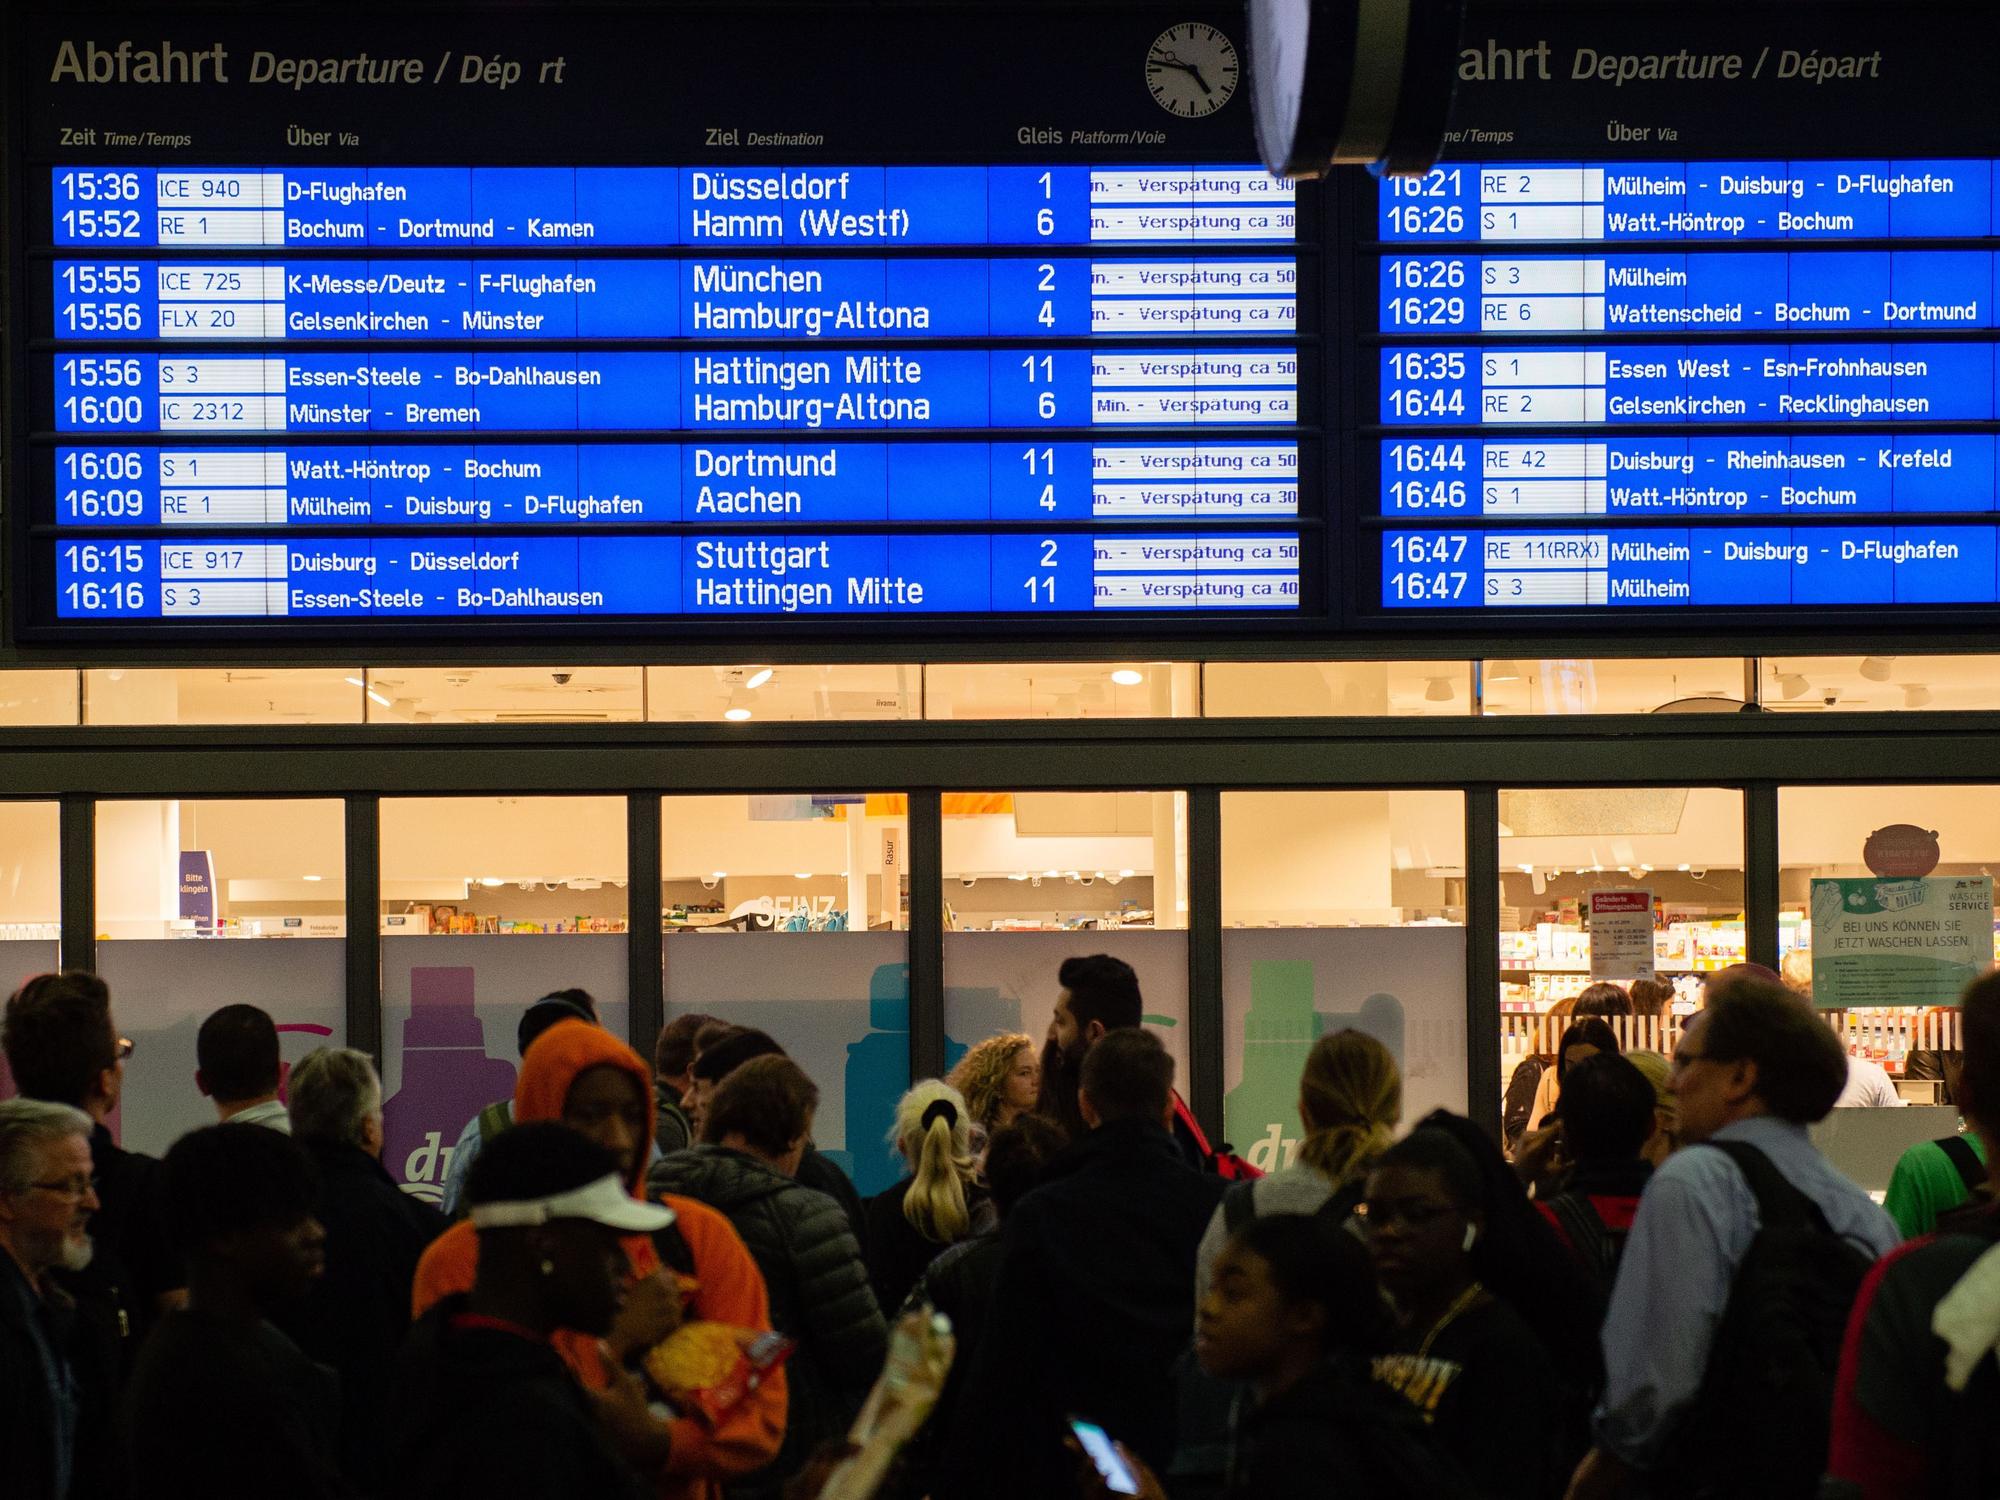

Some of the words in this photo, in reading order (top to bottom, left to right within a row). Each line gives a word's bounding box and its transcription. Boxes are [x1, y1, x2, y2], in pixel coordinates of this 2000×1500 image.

[50, 41, 229, 83] Abfahrt
[249, 52, 424, 91] Departure
[1458, 39, 1551, 81] ahrt
[1571, 48, 1742, 87] Departure
[1778, 47, 1882, 85] Départ
[60, 127, 97, 146] Zeit
[103, 131, 192, 149] Time/Temps
[287, 124, 332, 146] Über
[339, 132, 360, 146] Via
[705, 128, 740, 146] Ziel
[747, 132, 824, 146] Destination
[1017, 126, 1063, 145] Gleis
[1070, 130, 1166, 145] Platform/Voie
[1607, 120, 1651, 142] Über
[1657, 127, 1678, 141] Via
[60, 172, 140, 201] 15:36
[160, 179, 190, 198] ICE
[201, 179, 240, 198] 940
[287, 181, 407, 206] D-Flughafen
[692, 172, 850, 201] Düsseldorf
[1038, 171, 1051, 199] 1
[1387, 171, 1461, 197] 16:21
[1484, 175, 1507, 193] RE
[1519, 175, 1531, 193] 2
[1607, 176, 1686, 196] Mülheim
[1720, 175, 1804, 199] Duisburg
[1837, 173, 1954, 198] D-Flughafen
[61, 209, 141, 238] 15:52
[160, 216, 185, 235] RE
[198, 216, 207, 235] 1
[288, 218, 364, 238] Bochum
[399, 218, 494, 238] Dortmund
[527, 218, 594, 238] Kamen
[693, 209, 783, 237] Hamm
[799, 208, 909, 237] (Westf)
[1037, 208, 1055, 236] 6
[1387, 205, 1464, 233] 16:26
[1607, 212, 1745, 236] Watt.-Höntrop
[1778, 211, 1854, 231] Bochum
[62, 265, 141, 294] 15:55
[161, 272, 191, 291] ICE
[202, 272, 241, 291] 725
[288, 274, 446, 294] K-Messe/Deutz
[479, 273, 596, 298] F-Flughafen
[693, 264, 822, 293] München
[1038, 263, 1056, 291] 2
[1388, 260, 1465, 288] 16:26
[1608, 267, 1687, 287] Mülheim
[62, 303, 142, 331] 15:56
[161, 309, 198, 328] FLX
[210, 310, 235, 328] 20
[289, 311, 429, 331] Gelsenkirchen
[462, 310, 545, 331] Münster
[693, 301, 930, 336] Hamburg-Altona
[1038, 300, 1056, 328] 4
[1388, 297, 1465, 325] 16:29
[1485, 303, 1508, 321] RE
[1519, 303, 1531, 321] 6
[1608, 303, 1742, 323] Wattenscheid
[1775, 302, 1850, 322] Bochum
[1883, 301, 1977, 321] Dortmund
[62, 359, 142, 387] 15:56
[289, 366, 421, 386] Essen-Steele
[455, 366, 601, 386] Bo-Dahlhausen
[694, 356, 830, 391] Hattingen
[845, 356, 922, 383] Mitte
[1022, 355, 1053, 383] 11
[1388, 352, 1466, 380] 16:35
[1609, 359, 1667, 379] Essen
[1677, 358, 1730, 378] West
[1763, 357, 1928, 378] Esn-Frohnhausen
[63, 395, 143, 424] 16:00
[162, 402, 181, 421] IC
[192, 402, 244, 421] 2312
[289, 403, 372, 423] Münster
[406, 403, 481, 423] Bremen
[694, 392, 930, 428] Hamburg-Altona
[1038, 391, 1056, 419] 6
[1097, 399, 1130, 412] Min.
[1159, 398, 1261, 414] Verspätung
[1268, 401, 1289, 411] ca
[1388, 388, 1465, 417] 16:44
[1486, 395, 1509, 413] RE
[1520, 395, 1532, 413] 2
[1609, 395, 1746, 415] Gelsenkirchen
[1779, 393, 1929, 418] Recklinghausen
[63, 452, 143, 480] 16:06
[290, 459, 431, 483] Watt.-Höntrop
[464, 459, 541, 479] Bochum
[695, 448, 837, 477] Dortmund
[1022, 447, 1054, 476] 11
[1389, 444, 1466, 472] 16:44
[1486, 450, 1510, 468] RE
[1521, 450, 1546, 468] 42
[1610, 451, 1694, 475] Duisburg
[1727, 450, 1845, 470] Rheinhausen
[1878, 448, 1952, 468] Krefeld
[64, 489, 143, 517] 16:09
[163, 495, 188, 514] RE
[201, 495, 210, 514] 1
[290, 496, 371, 516] Mülheim
[405, 496, 491, 520] Duisburg
[525, 494, 643, 519] D-Flughafen
[695, 485, 801, 513] Aachen
[1039, 484, 1057, 512] 4
[1389, 480, 1466, 509] 16:46
[1610, 487, 1748, 510] Watt.-Höntrop
[1781, 486, 1857, 505] Bochum
[64, 545, 144, 573] 16:15
[164, 551, 193, 570] ICE
[205, 551, 244, 569] 917
[696, 542, 830, 570] Stuttgart
[1040, 541, 1058, 567] 2
[1391, 535, 1468, 563] 16:47
[1487, 541, 1511, 560] RE
[1523, 538, 1600, 563] 11(RRX)
[1611, 542, 1690, 561] Mülheim
[1724, 541, 1809, 565] Duisburg
[1841, 539, 1959, 564] D-Flughafen
[290, 552, 377, 576] Duisburg
[410, 551, 520, 571] Düsseldorf
[65, 581, 144, 610] 16:16
[291, 588, 424, 608] Essen-Steele
[457, 587, 603, 607] Bo-Dahlhausen
[696, 579, 832, 612] Hattingen
[847, 579, 923, 605] Mitte
[1023, 578, 1055, 603] 11
[1390, 571, 1468, 600] 16:47
[1611, 578, 1690, 598] Mülheim
[885, 840, 894, 865] Rasur
[185, 873, 203, 882] Bitte
[1949, 902, 1990, 911] SERVICE
[1843, 921, 1861, 933] BEI
[1865, 921, 1889, 932] UNS
[1893, 919, 1940, 932] KÖNNEN
[1944, 920, 1961, 931] SIE
[1834, 937, 1865, 949] JETZT
[1868, 936, 1922, 948] WASCHEN
